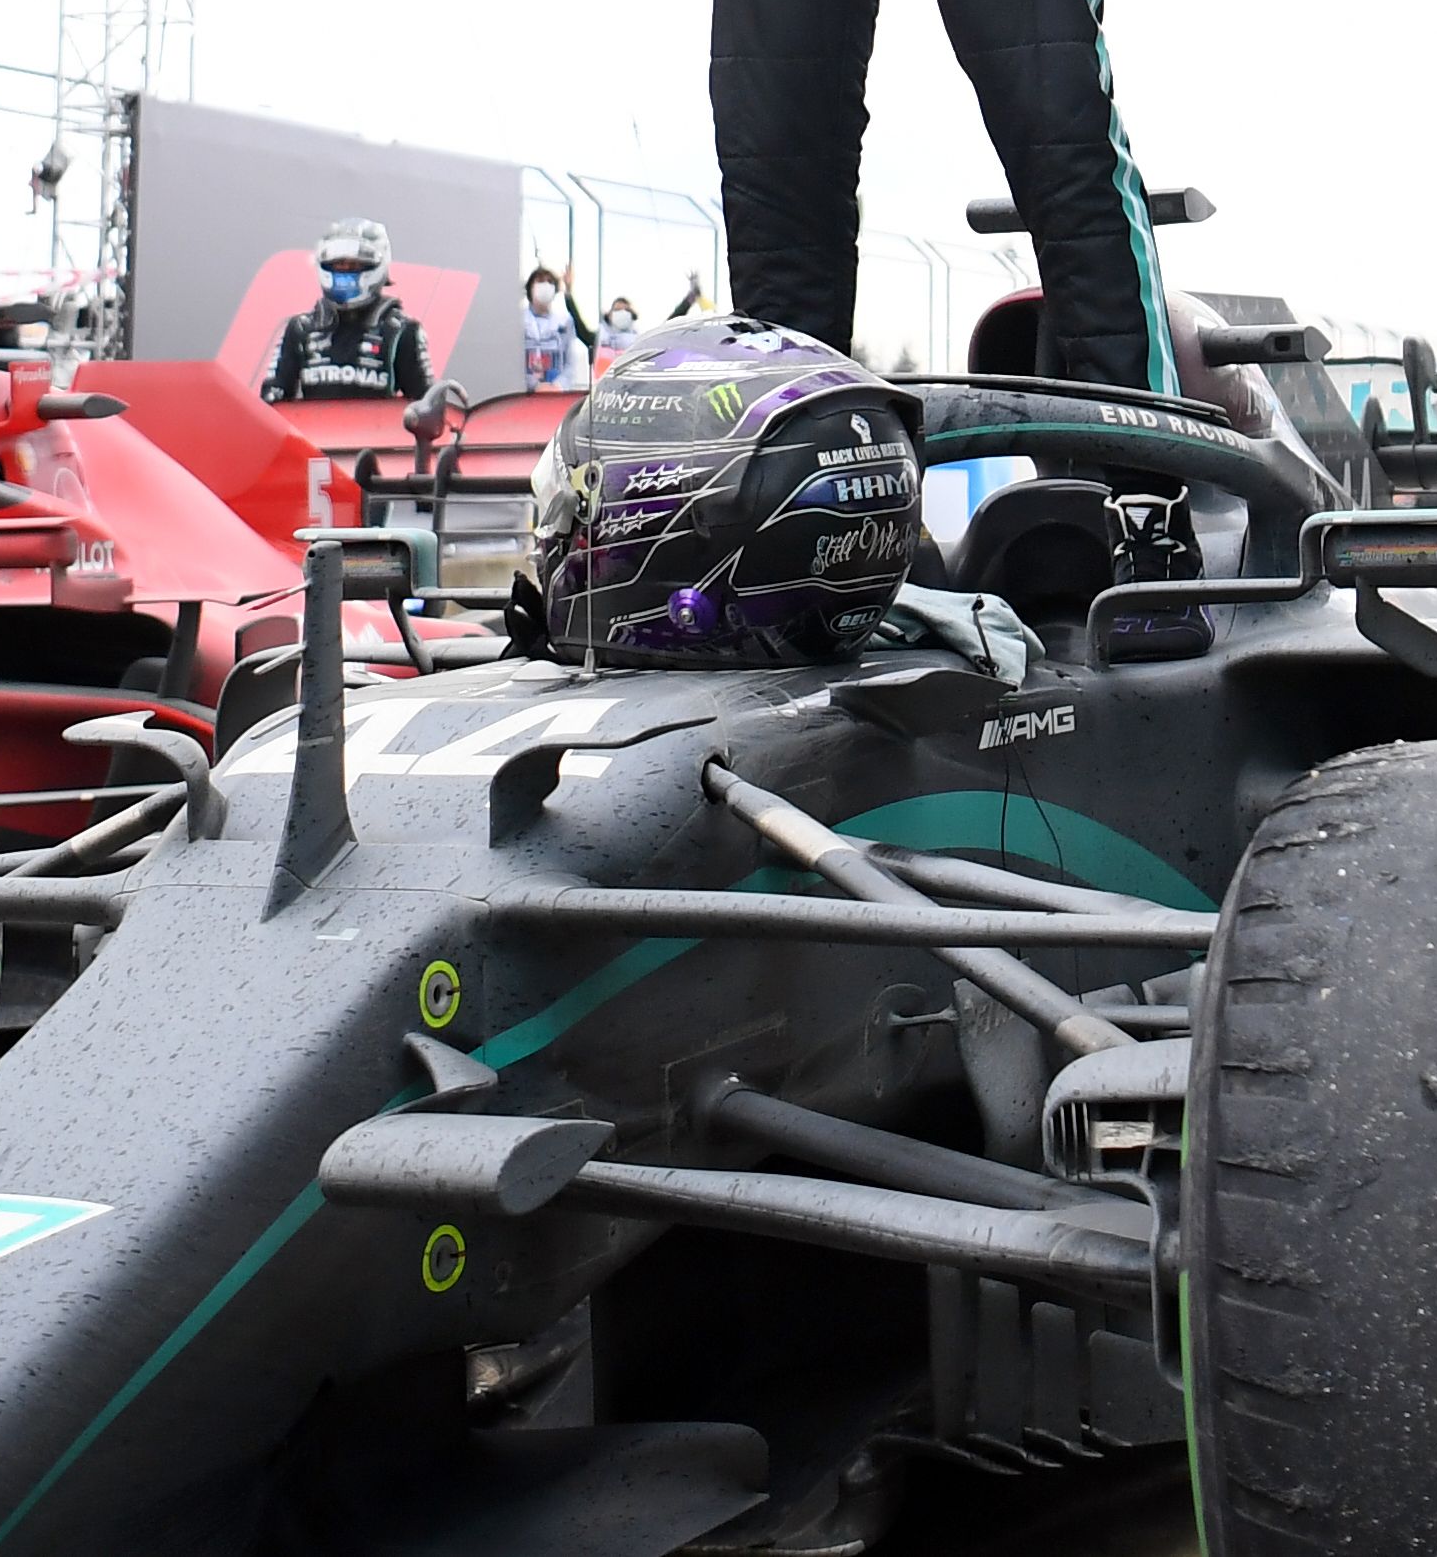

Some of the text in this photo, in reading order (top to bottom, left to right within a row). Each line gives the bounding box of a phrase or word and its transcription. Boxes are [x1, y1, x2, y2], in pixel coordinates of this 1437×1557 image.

[1099, 404, 1251, 453] END RACISM
[817, 448, 855, 467] BLACK
[856, 445, 880, 463] LIVES
[306, 457, 334, 529] 5
[837, 610, 876, 628] BELL
[1011, 704, 1076, 743] AMG
